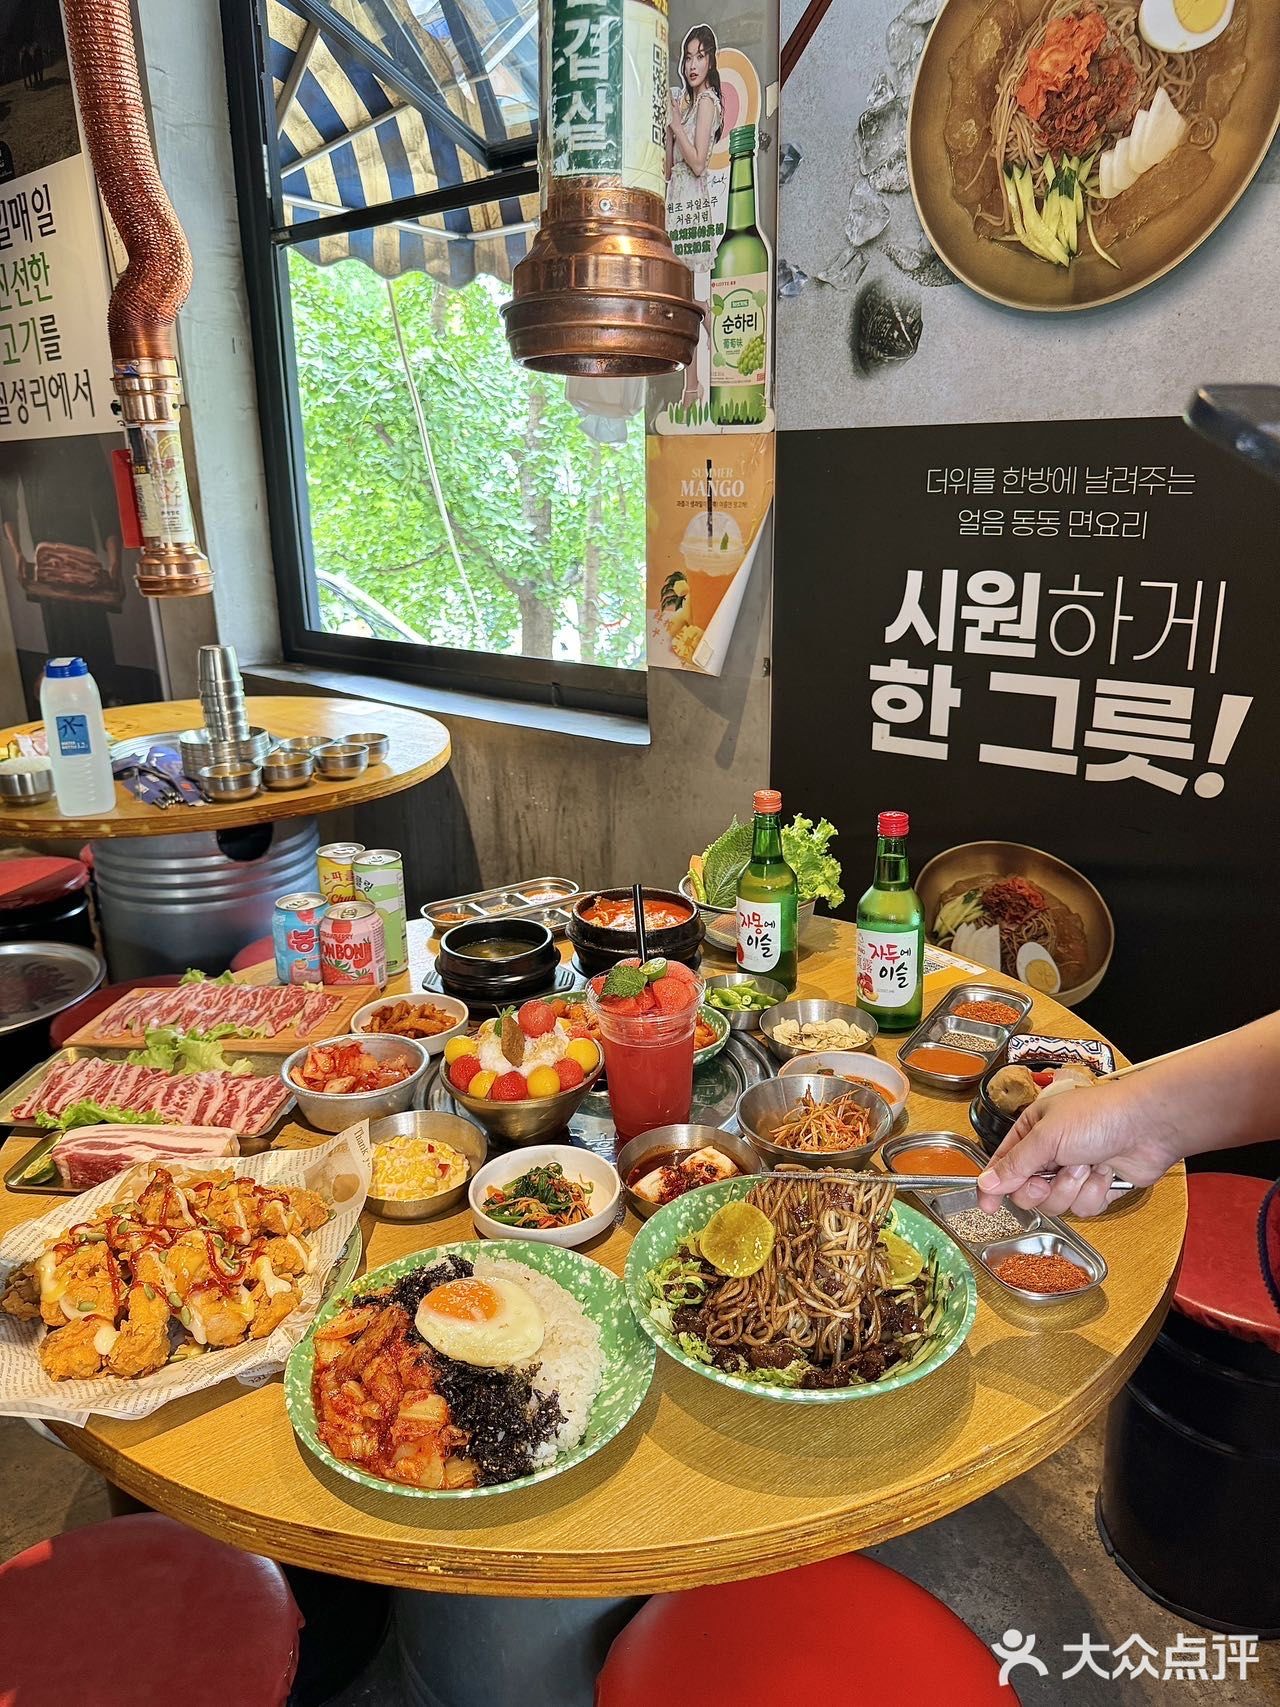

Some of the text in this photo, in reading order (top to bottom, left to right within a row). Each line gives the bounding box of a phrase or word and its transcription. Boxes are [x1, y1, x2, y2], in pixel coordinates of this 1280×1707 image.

[562, 0, 616, 151] 겹살
[676, 210, 709, 225] 처음처럼
[722, 312, 757, 335] 순하리
[0, 314, 63, 366] 고기를
[680, 479, 745, 498] MANGO
[926, 466, 1196, 496] 더위를 한방에 날려주는
[958, 508, 1148, 539] 얼음 동동 면요리
[885, 568, 1227, 674] 시원하게
[869, 658, 1254, 799] 한 그릇!
[740, 912, 776, 935] 자몽에
[746, 933, 774, 958] 이슬
[867, 943, 912, 964] 자두에
[879, 961, 909, 988] 이슬
[354, 1126, 369, 1156] Thank
